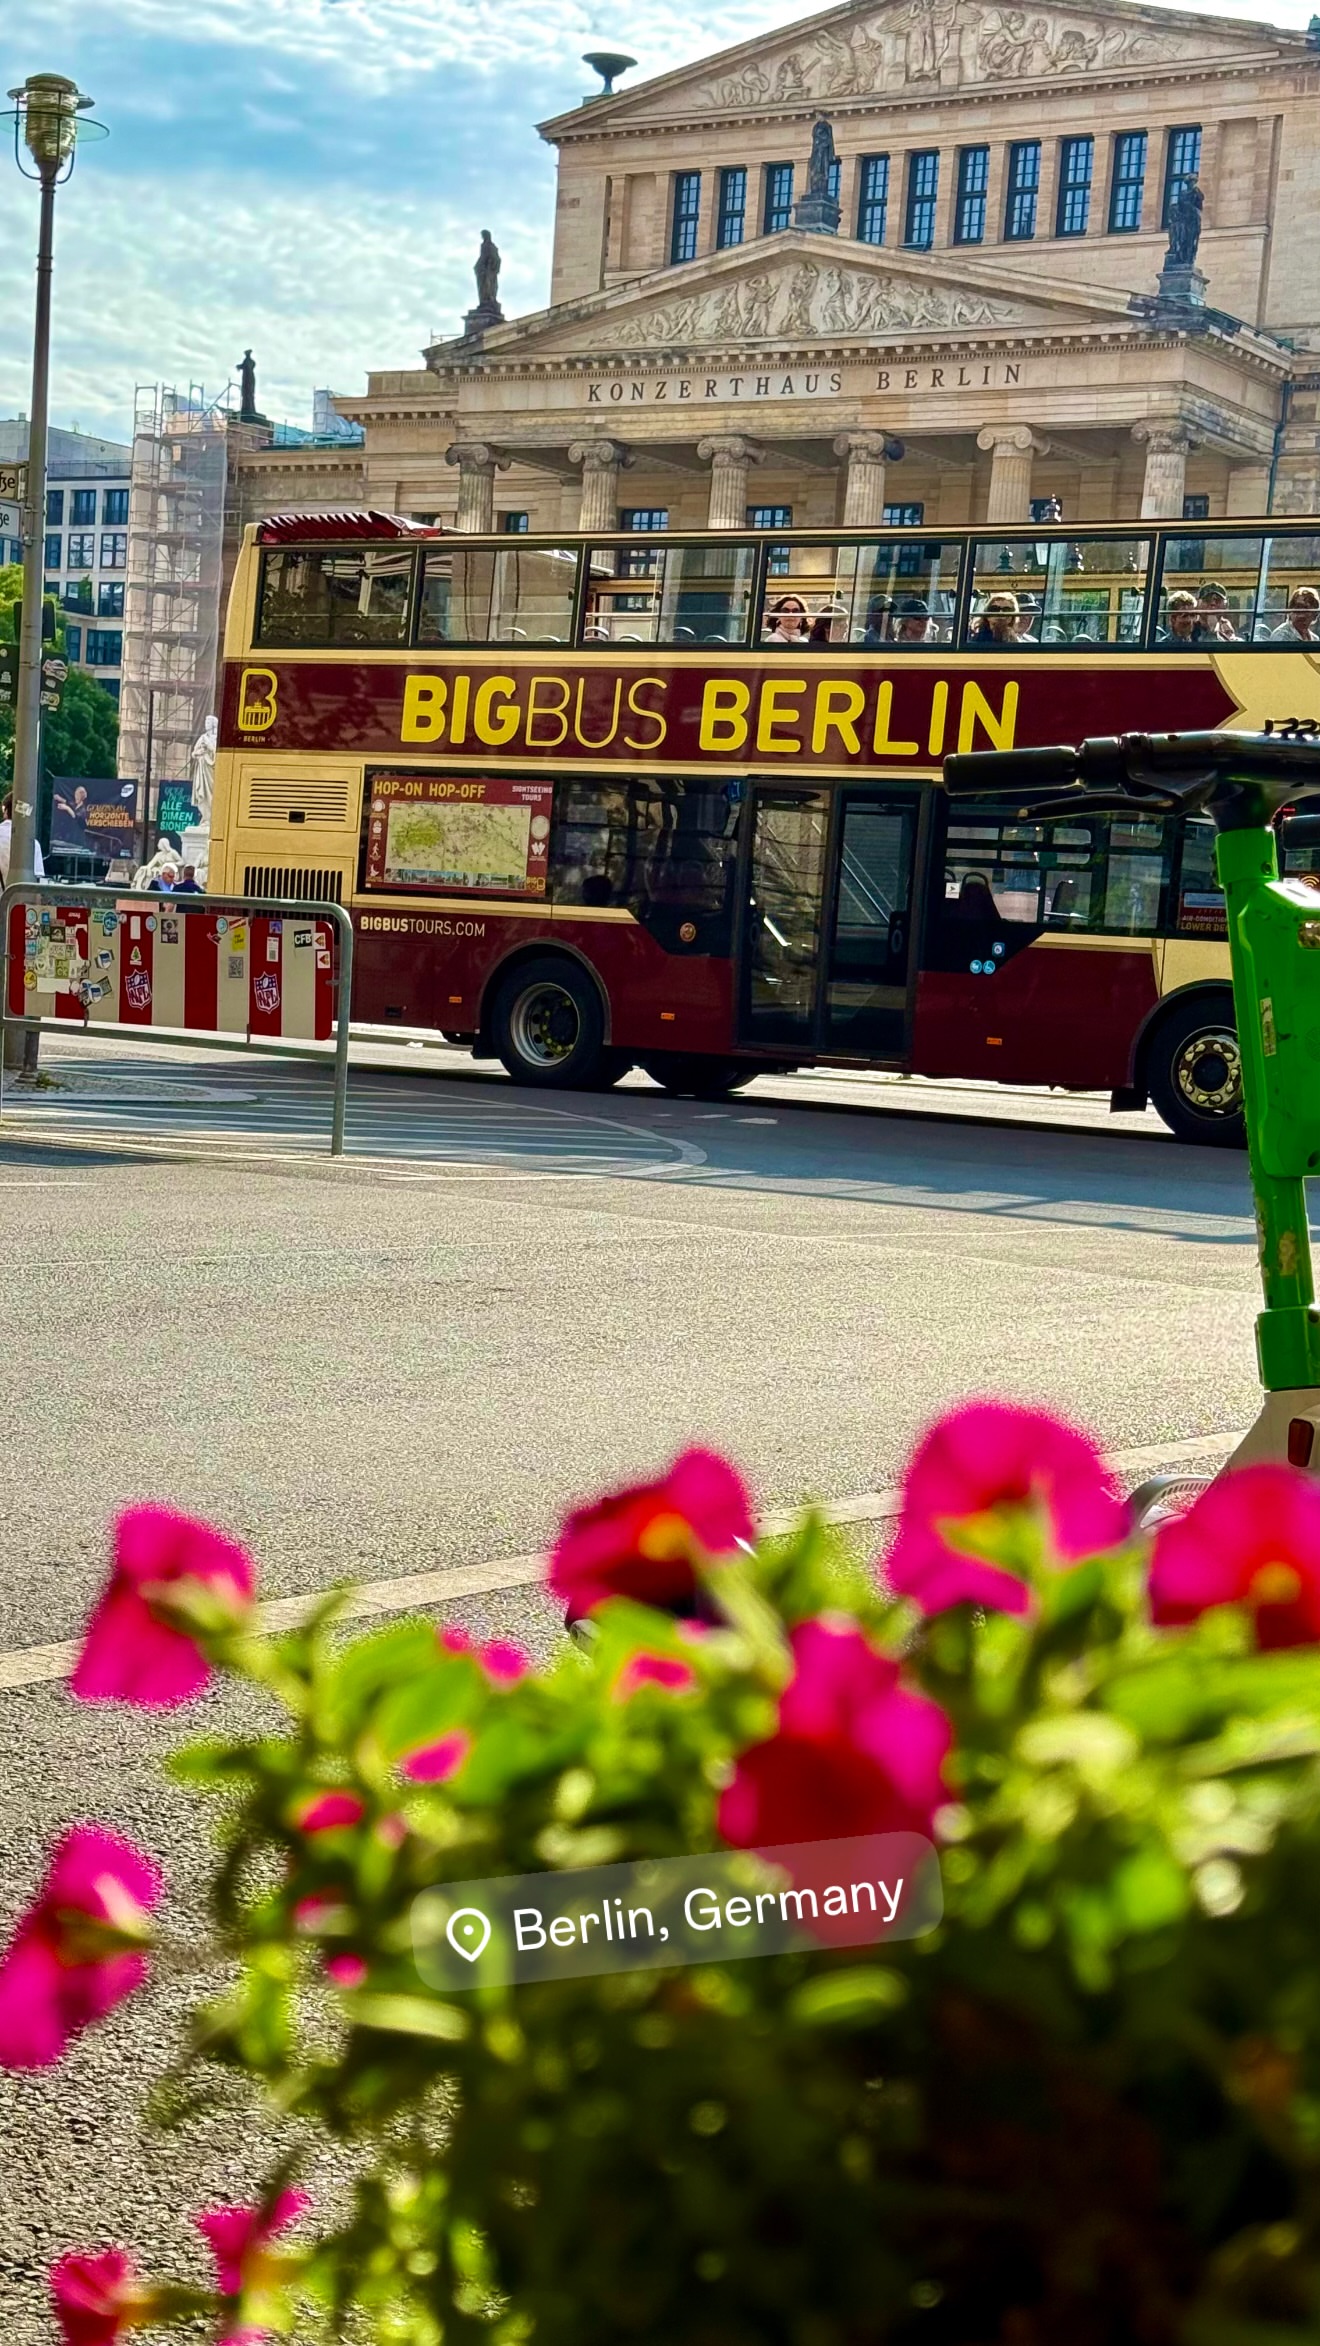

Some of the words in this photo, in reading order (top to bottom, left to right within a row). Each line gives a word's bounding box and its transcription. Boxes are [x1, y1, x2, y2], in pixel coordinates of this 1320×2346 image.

[588, 373, 842, 402] KONZERTHAUS
[876, 364, 1021, 390] BERLIN
[400, 675, 668, 750] BIGBUS
[699, 679, 1019, 756] BERLIN
[243, 735, 266, 743] BERLIN
[373, 781, 423, 796] HOP-ON
[429, 782, 486, 799] HOP-OFF
[511, 785, 553, 794] SIGHTSEEING
[521, 793, 542, 801] TOURS
[160, 800, 183, 811] ALLE
[89, 811, 129, 820] HORIZONTE
[161, 810, 194, 822] DIMEN
[84, 818, 134, 828] VERSCHIEBEN
[360, 915, 486, 937] BIGBUSTOURS.COM
[1180, 922, 1212, 931] LOWER
[294, 933, 311, 944] CFB
